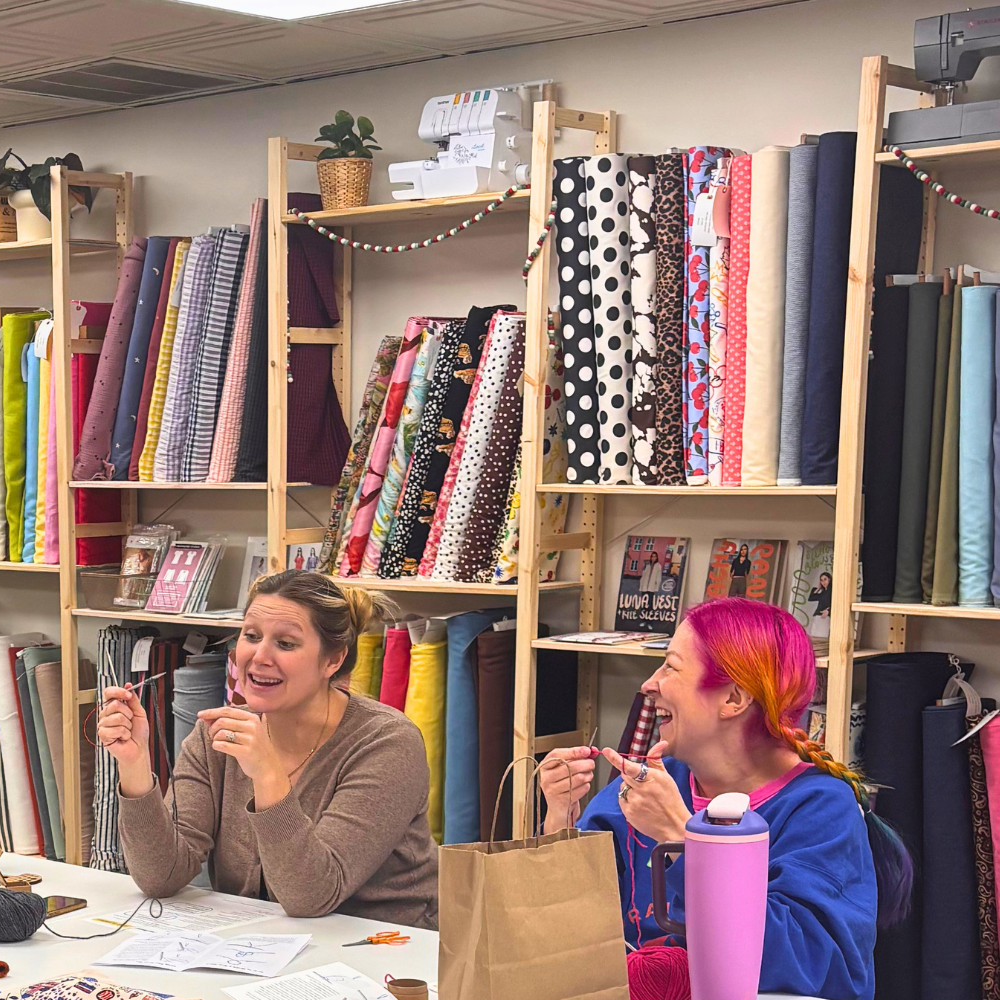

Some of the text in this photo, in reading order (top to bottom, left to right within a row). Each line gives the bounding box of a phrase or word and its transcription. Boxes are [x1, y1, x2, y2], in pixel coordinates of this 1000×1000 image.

[619, 593, 680, 611] LUNA VEST
[639, 609, 677, 623] SLEEVES
